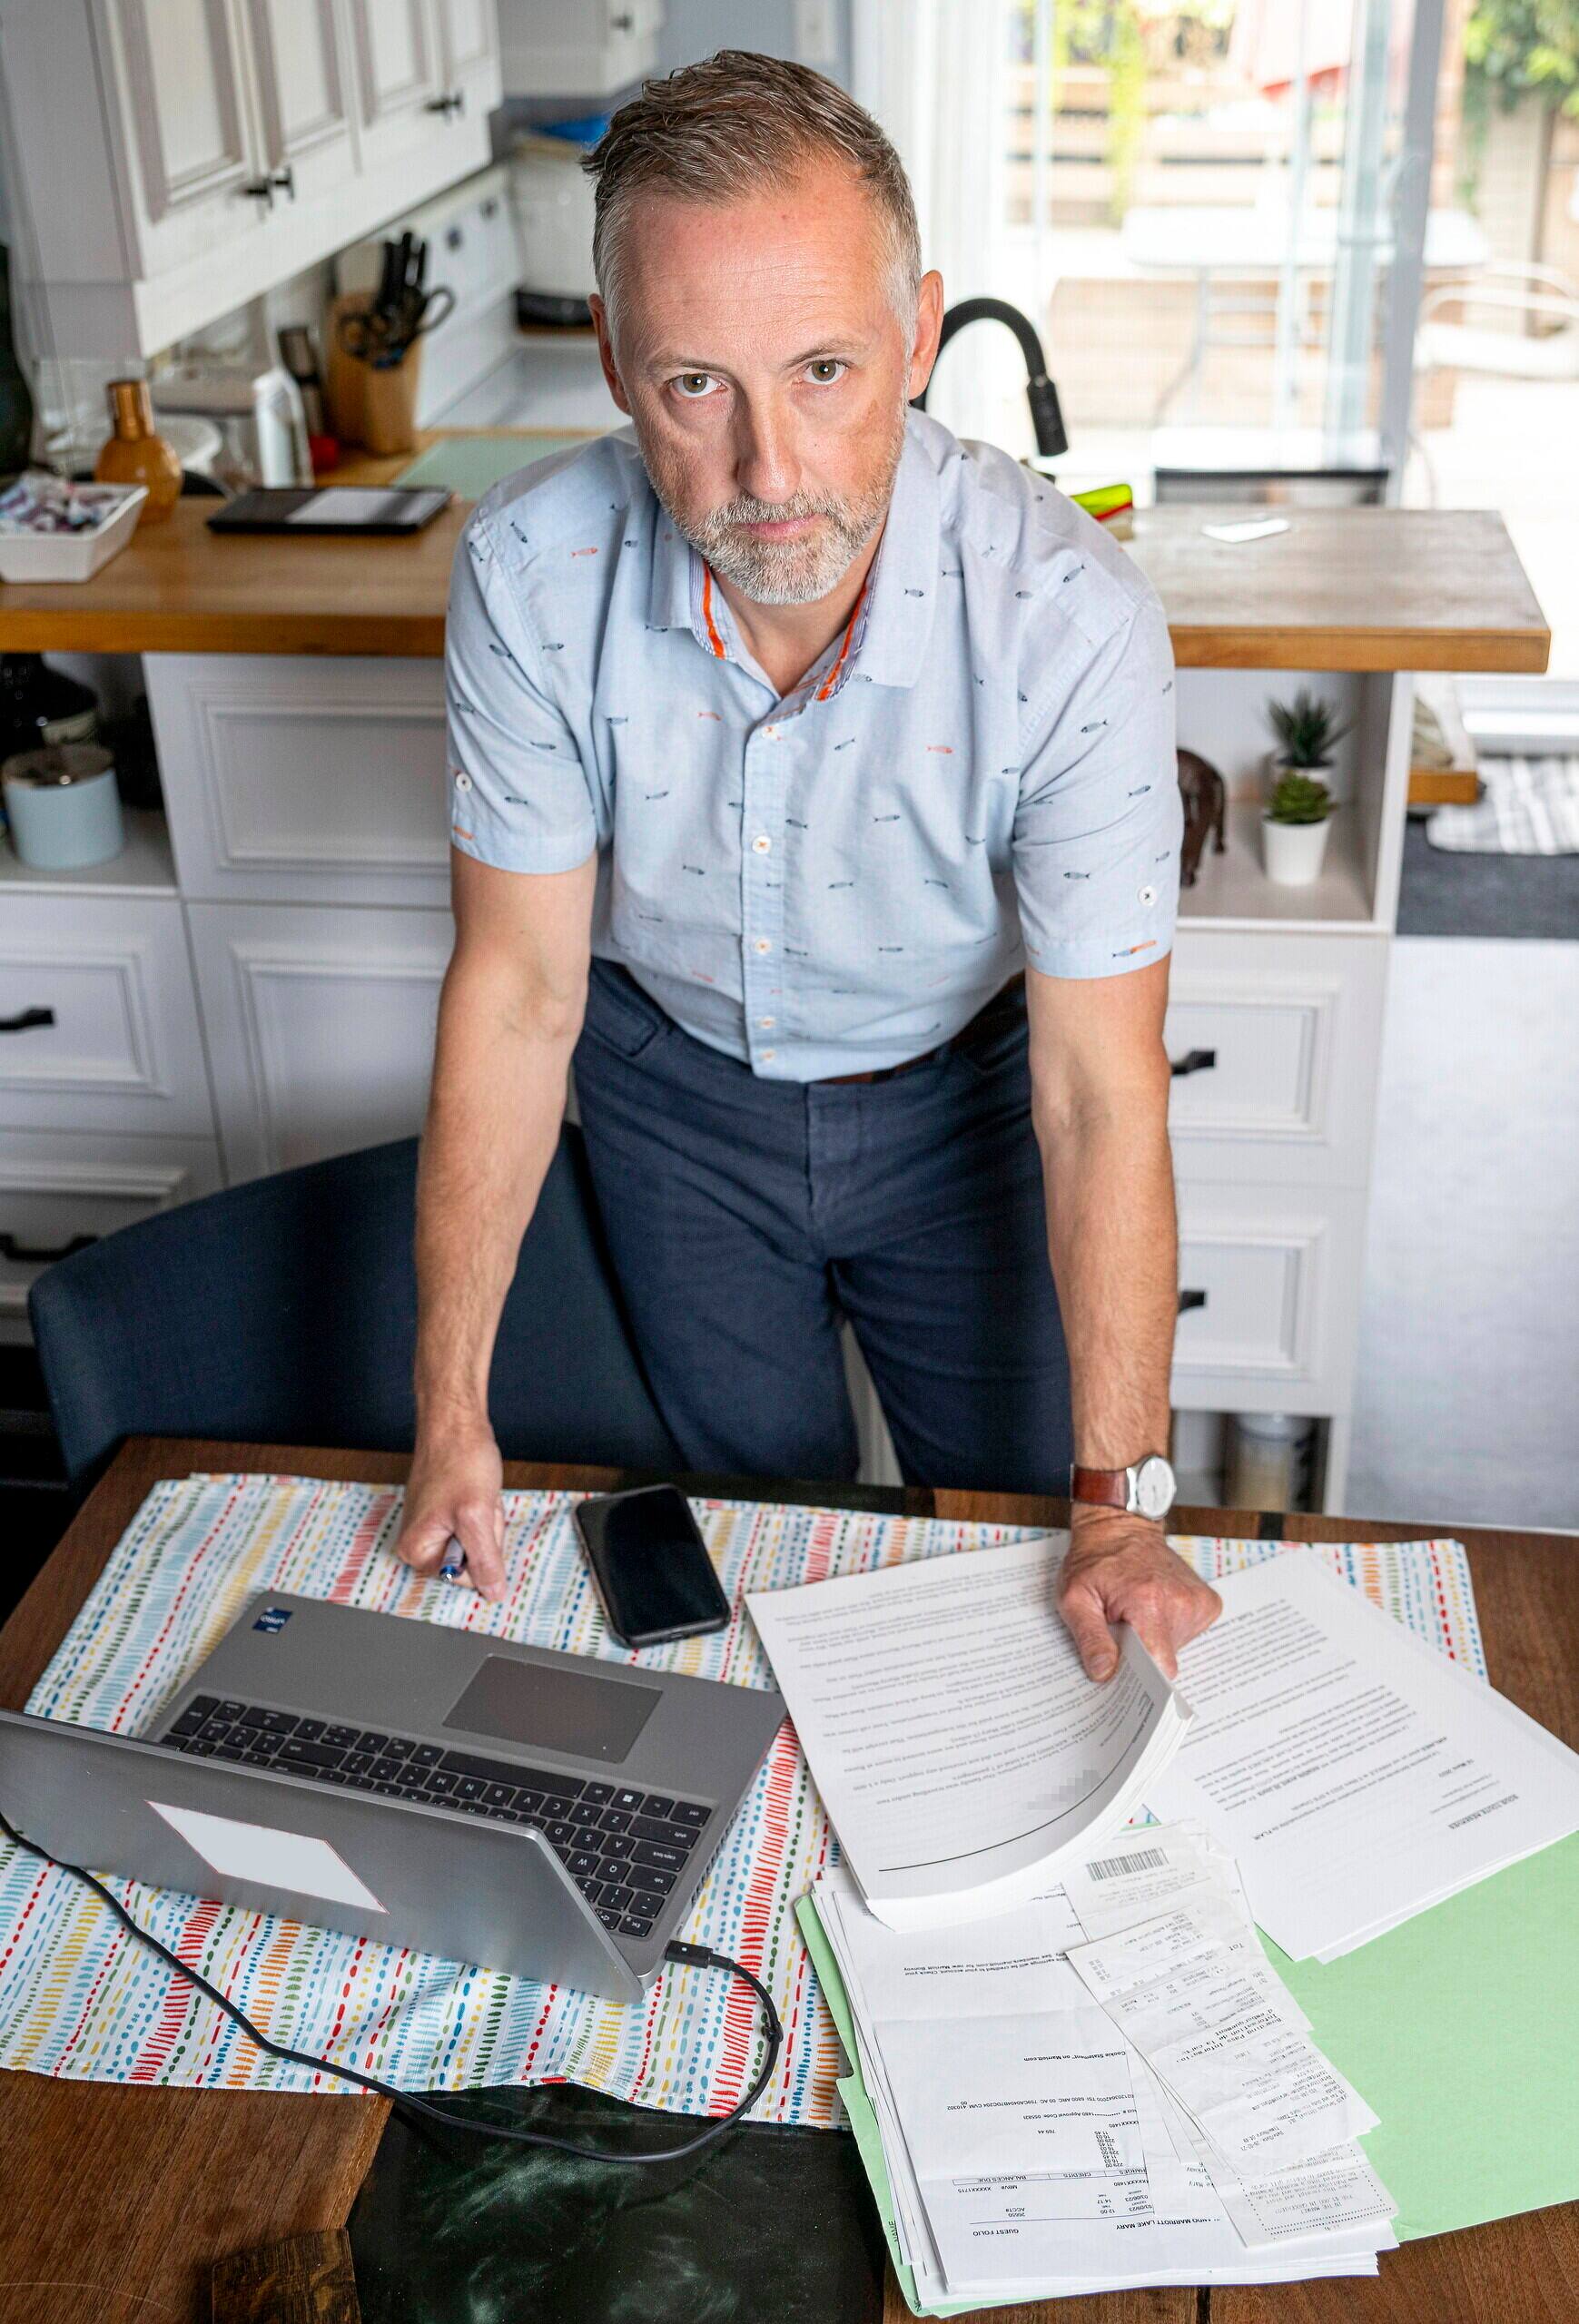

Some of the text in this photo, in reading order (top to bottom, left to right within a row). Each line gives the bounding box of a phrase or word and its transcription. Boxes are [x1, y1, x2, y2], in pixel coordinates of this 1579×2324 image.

[611, 1816, 619, 1824] Z
[585, 1834, 592, 1842] S
[609, 1865, 617, 1873] Q
[1230, 2014, 1277, 2035] Information
[1247, 2017, 1282, 2034] Boarding
[1227, 2034, 1245, 2043] Pass
[1119, 2166, 1147, 2175] HARGES
[1137, 2220, 1155, 2228] LAKE
